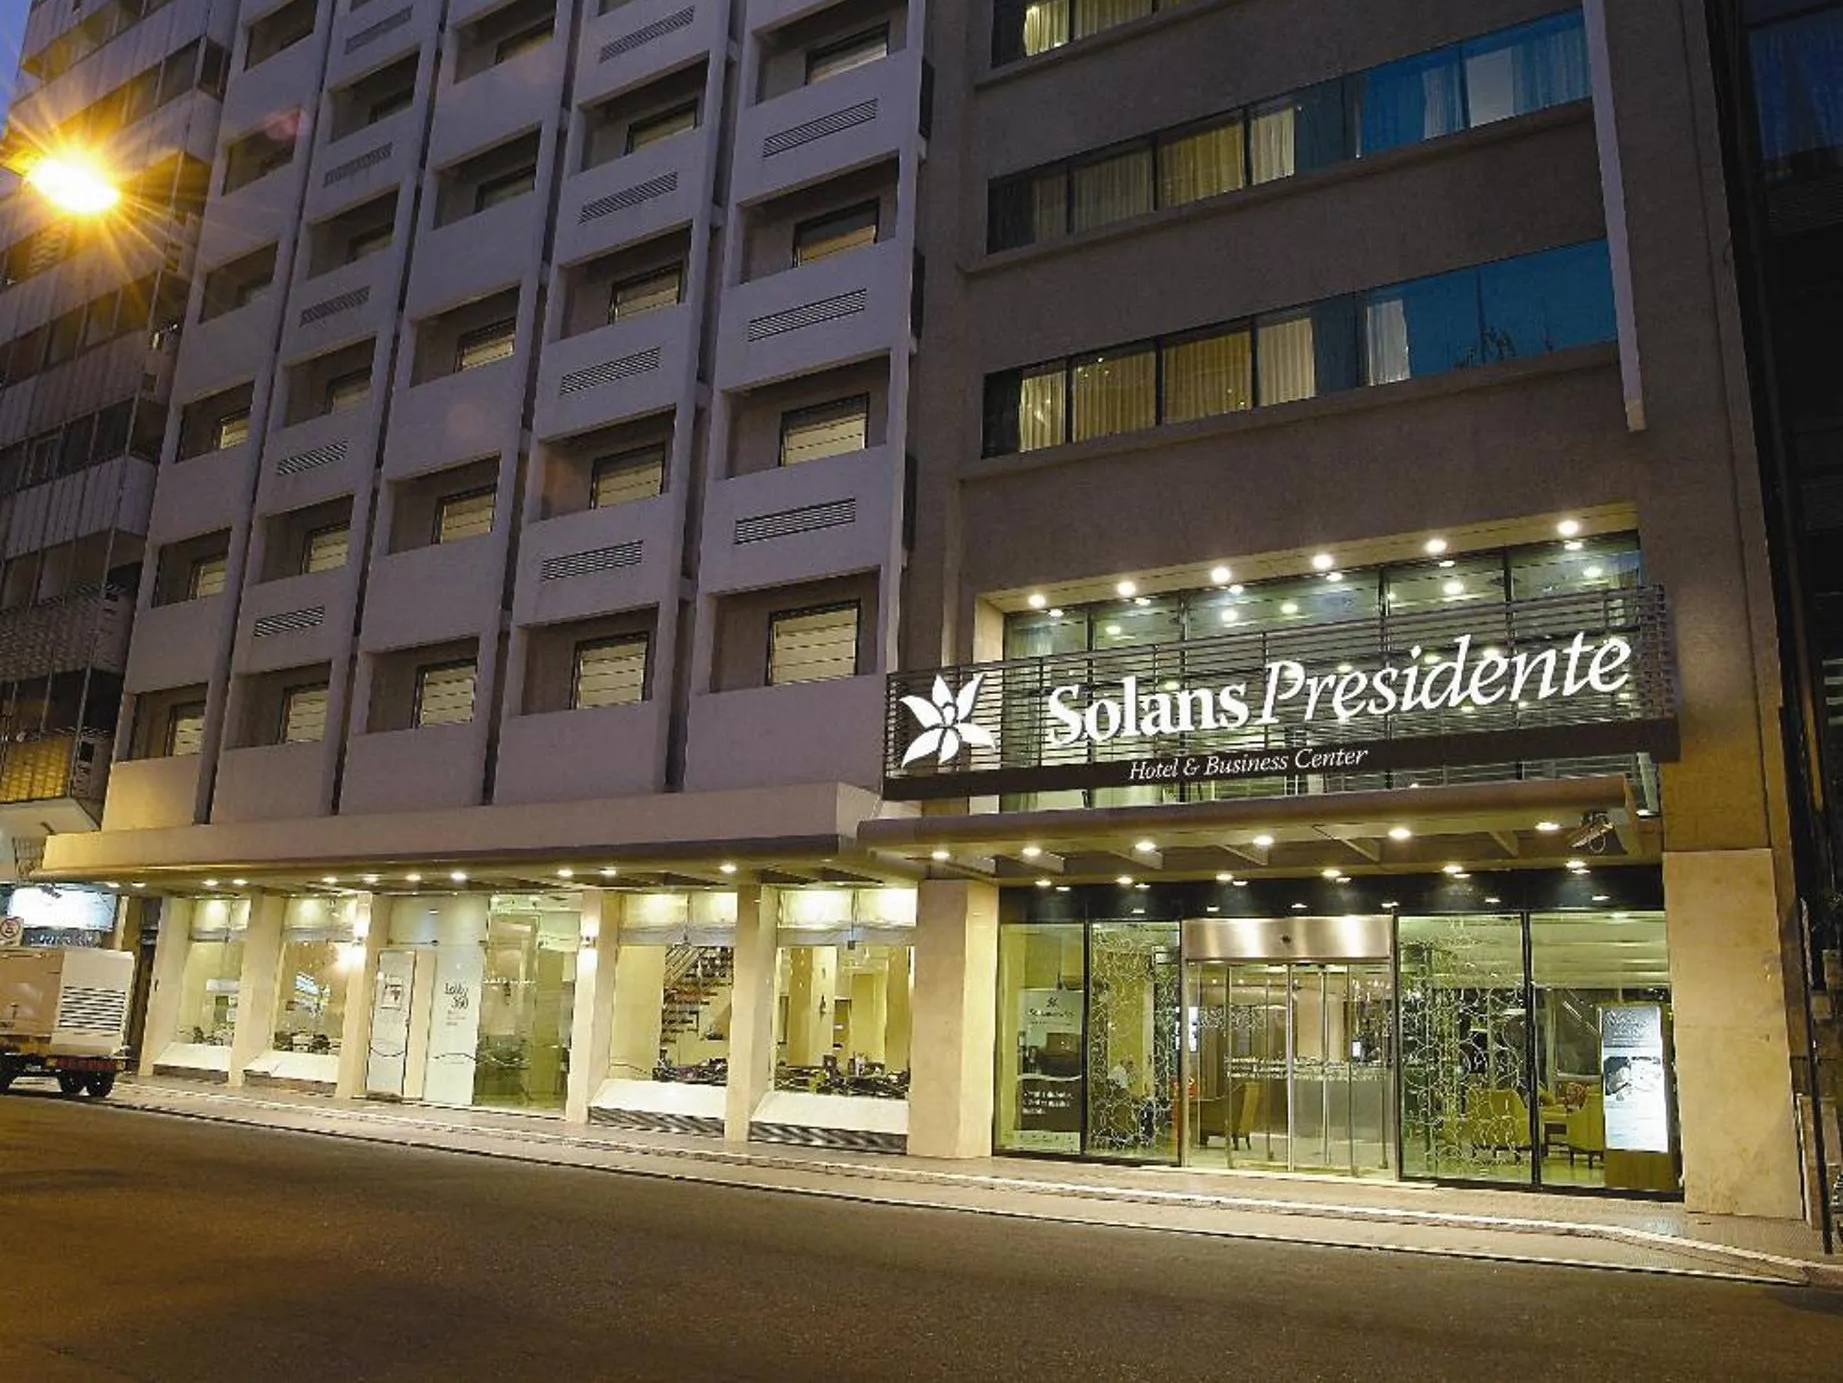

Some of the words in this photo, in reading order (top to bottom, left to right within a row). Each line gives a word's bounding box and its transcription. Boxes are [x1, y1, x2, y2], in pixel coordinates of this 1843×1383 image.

[1043, 676, 1249, 749] Solans
[1254, 632, 1633, 725] Presidente
[1129, 758, 1179, 780] Hotel
[1183, 757, 1200, 776] &
[1204, 753, 1289, 776] Business
[1295, 748, 1369, 768] Center
